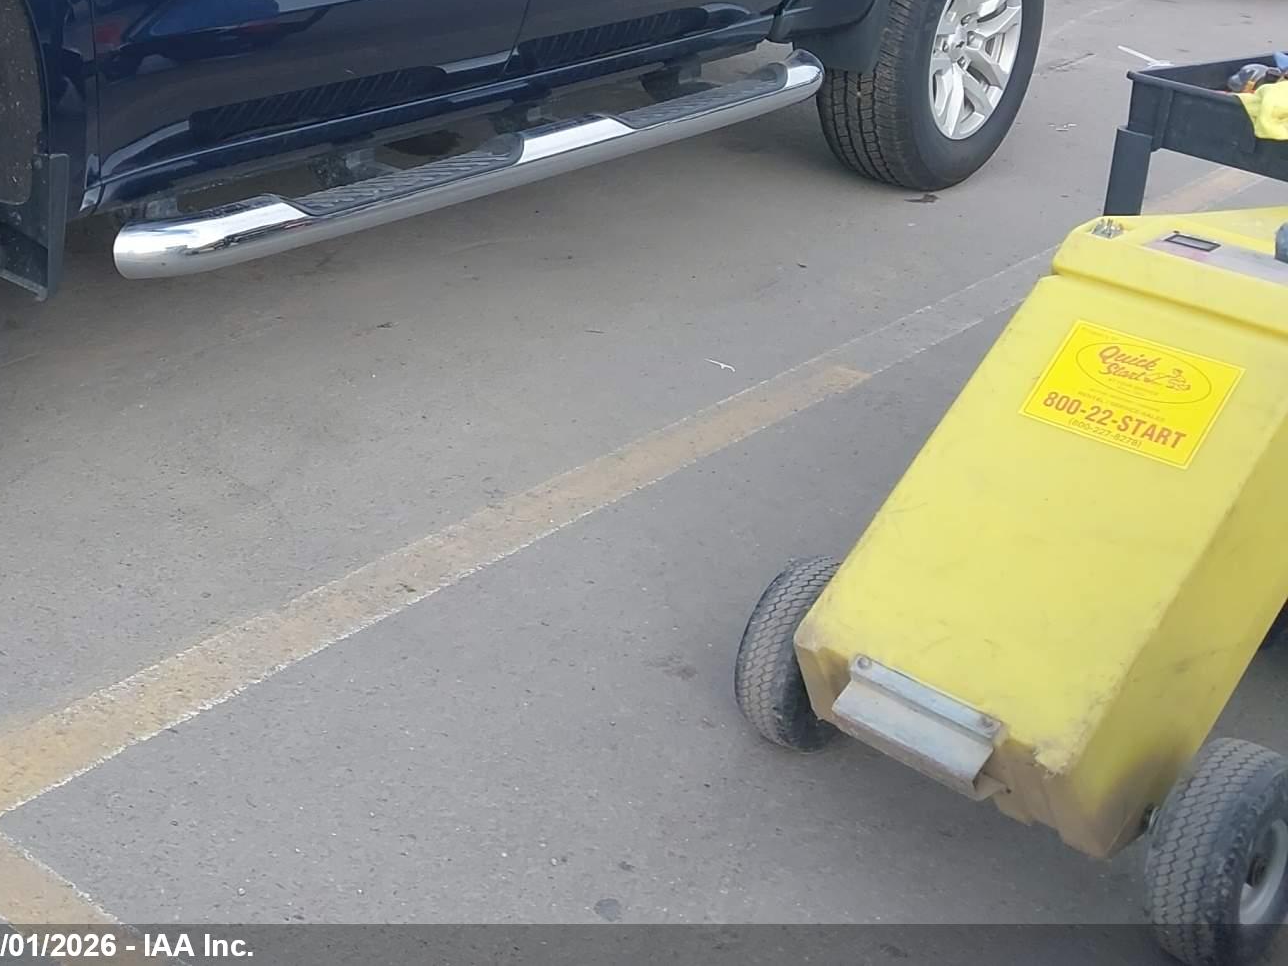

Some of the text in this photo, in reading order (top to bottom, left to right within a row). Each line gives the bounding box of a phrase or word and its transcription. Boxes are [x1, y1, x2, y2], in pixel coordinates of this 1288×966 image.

[1098, 345, 1161, 372] Quick
[1099, 362, 1147, 382] Start
[1043, 391, 1187, 449] 800-22-START
